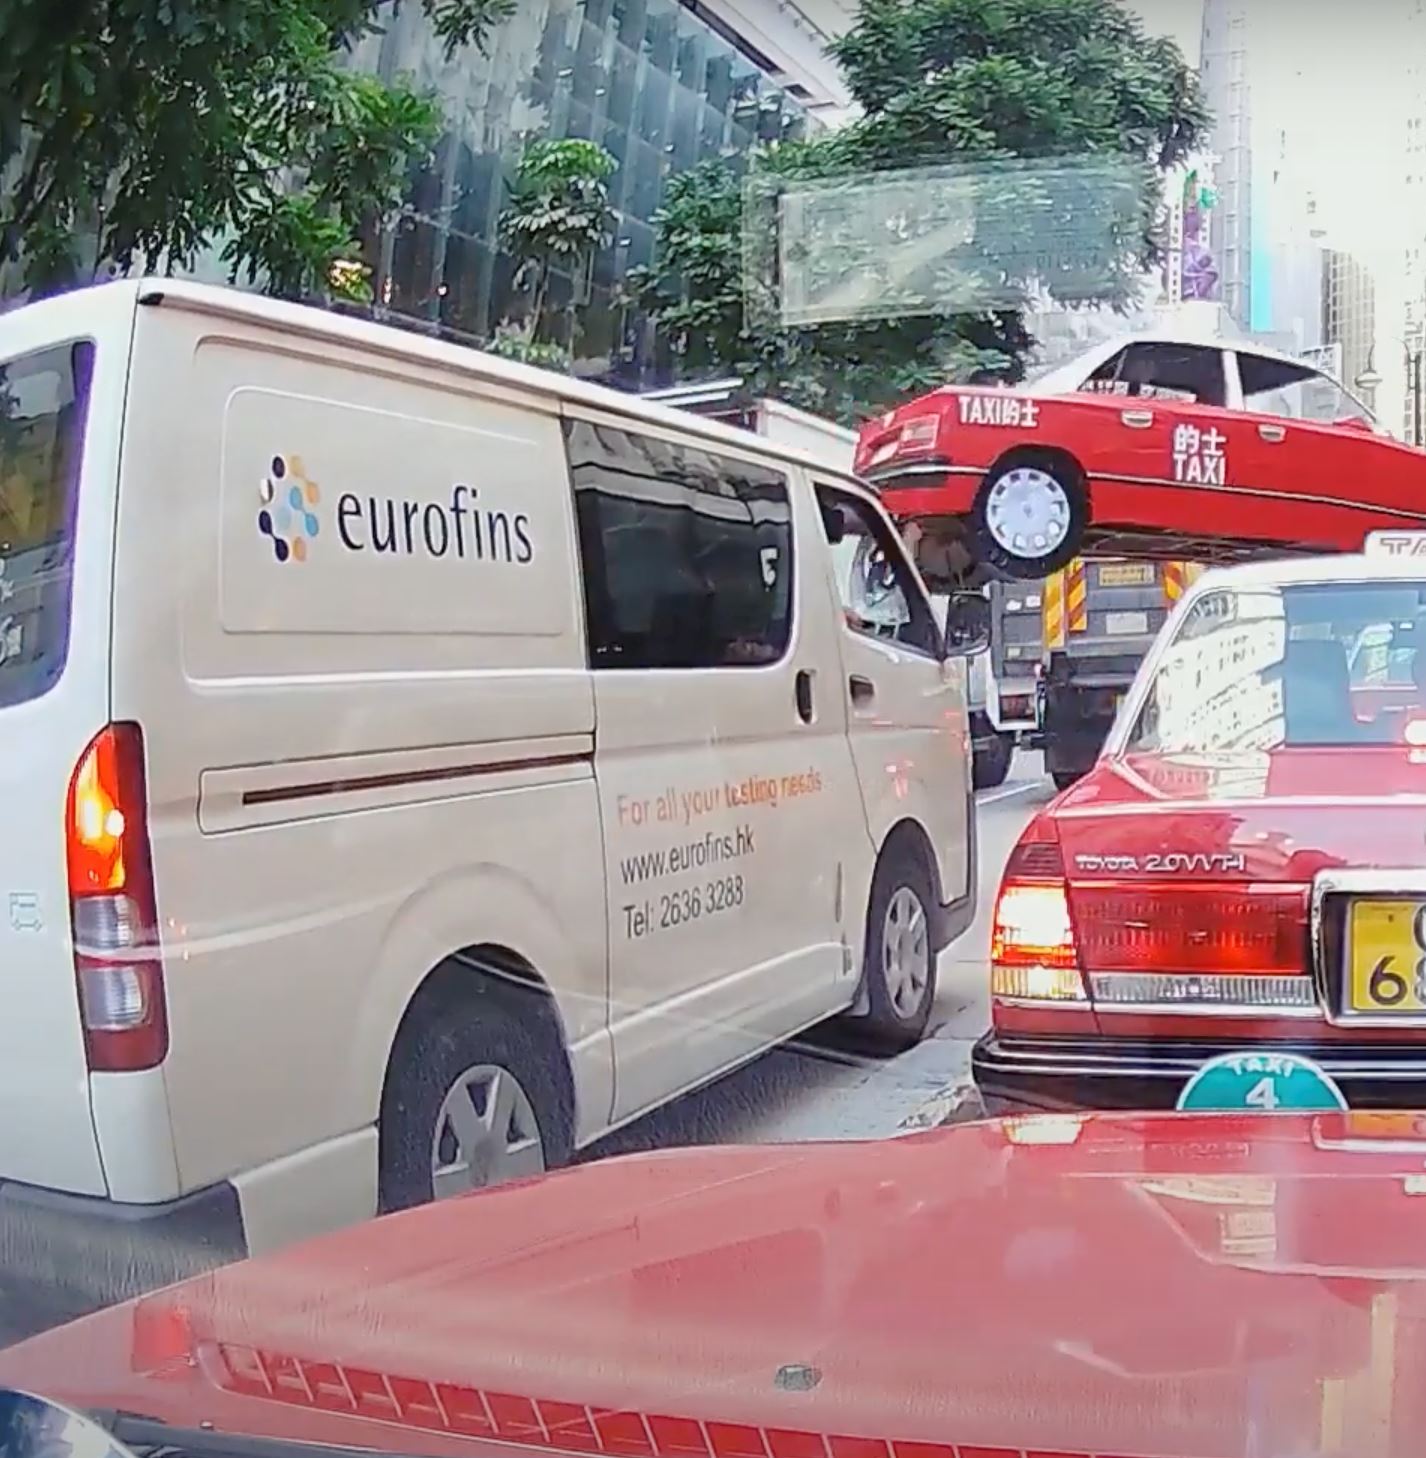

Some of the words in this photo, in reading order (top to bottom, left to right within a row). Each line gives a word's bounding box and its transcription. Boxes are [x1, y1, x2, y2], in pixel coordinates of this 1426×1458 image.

[1173, 423, 1226, 456] 的士
[1173, 453, 1226, 485] TAXI
[337, 485, 533, 563] eurofins
[616, 794, 650, 826] For
[656, 786, 678, 822] all
[680, 786, 720, 826] your
[724, 774, 778, 808] testing
[780, 766, 823, 800] needs
[620, 824, 755, 885] www.eurofins.hk
[1075, 855, 1139, 871] TOYOTA
[623, 899, 655, 940] Tel:
[660, 884, 702, 929] 2636
[1230, 1057, 1295, 1078] TAXI
[1246, 1077, 1280, 1110] 4
